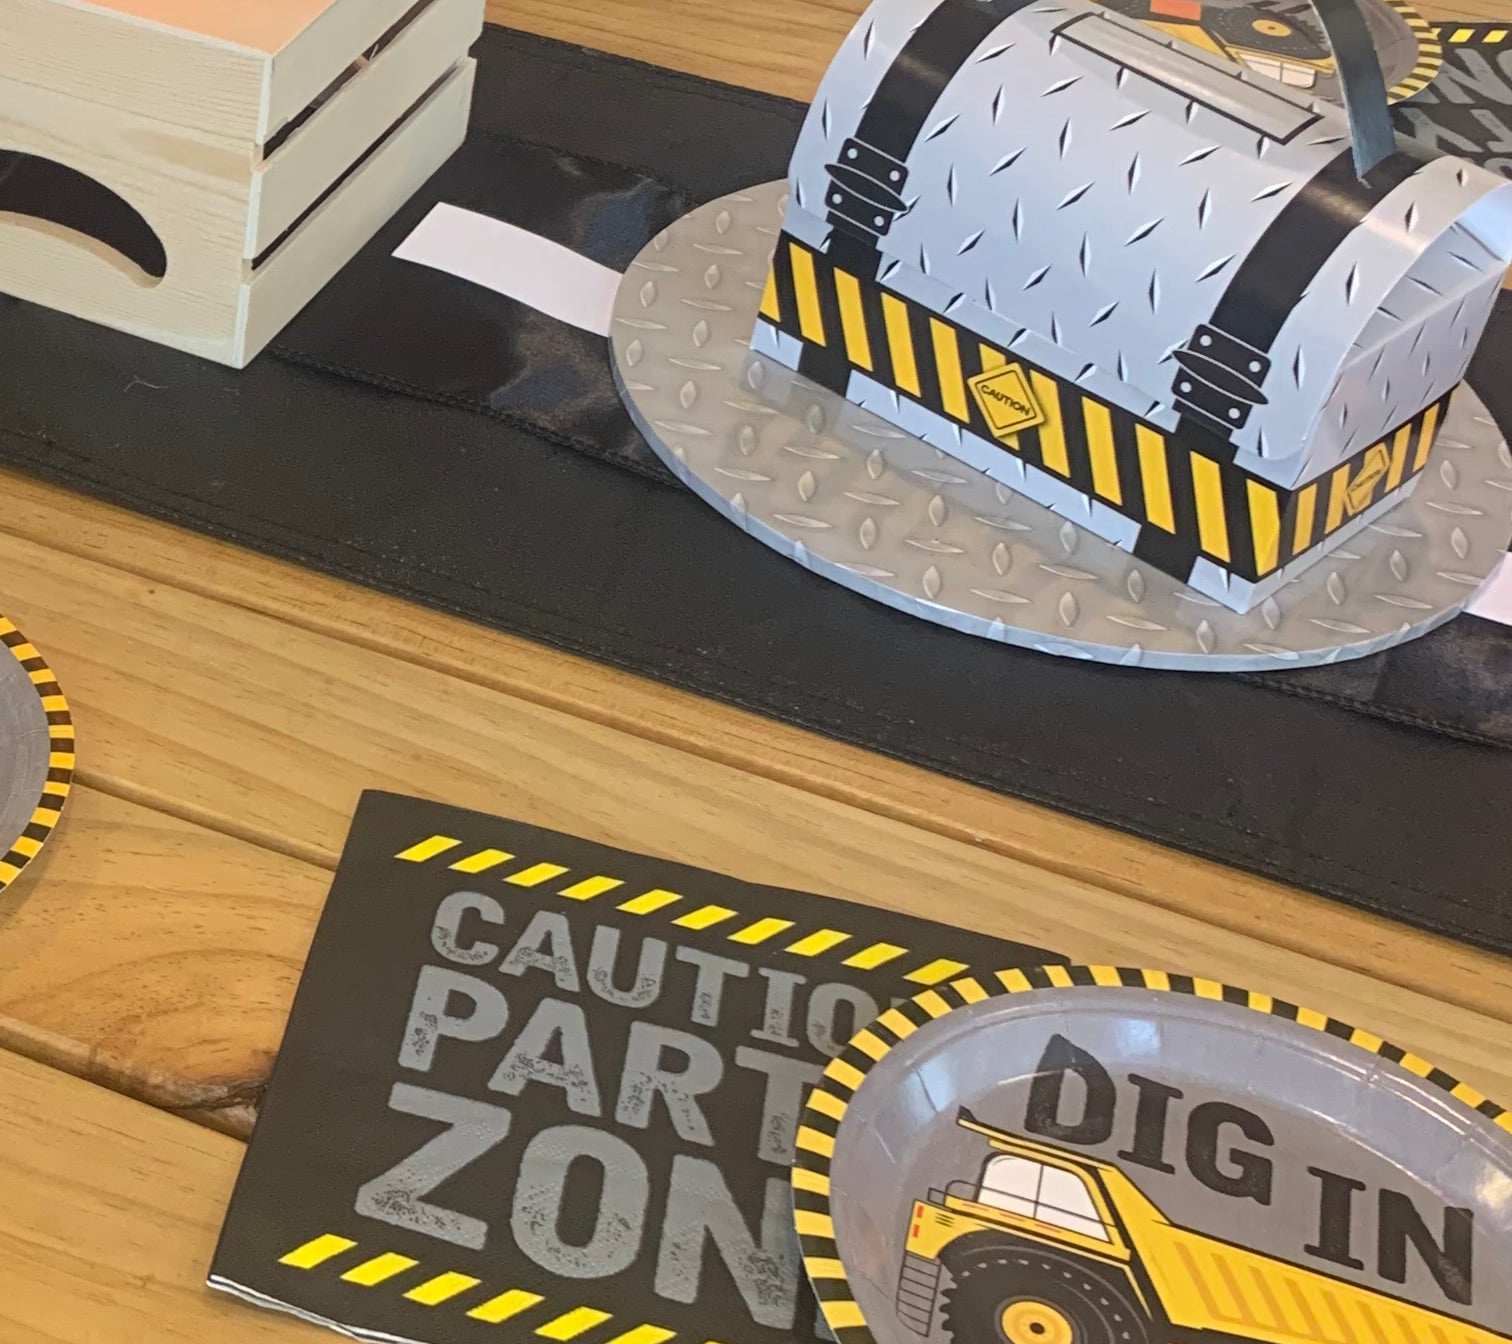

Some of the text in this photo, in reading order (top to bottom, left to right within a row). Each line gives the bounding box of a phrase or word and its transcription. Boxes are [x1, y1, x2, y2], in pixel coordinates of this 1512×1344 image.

[981, 384, 1030, 416] CAUTION
[397, 964, 828, 1166] PART
[429, 890, 908, 1056] CAUTIO
[354, 1082, 834, 1340] ZON
[1024, 1033, 1474, 1306] DIG IN
